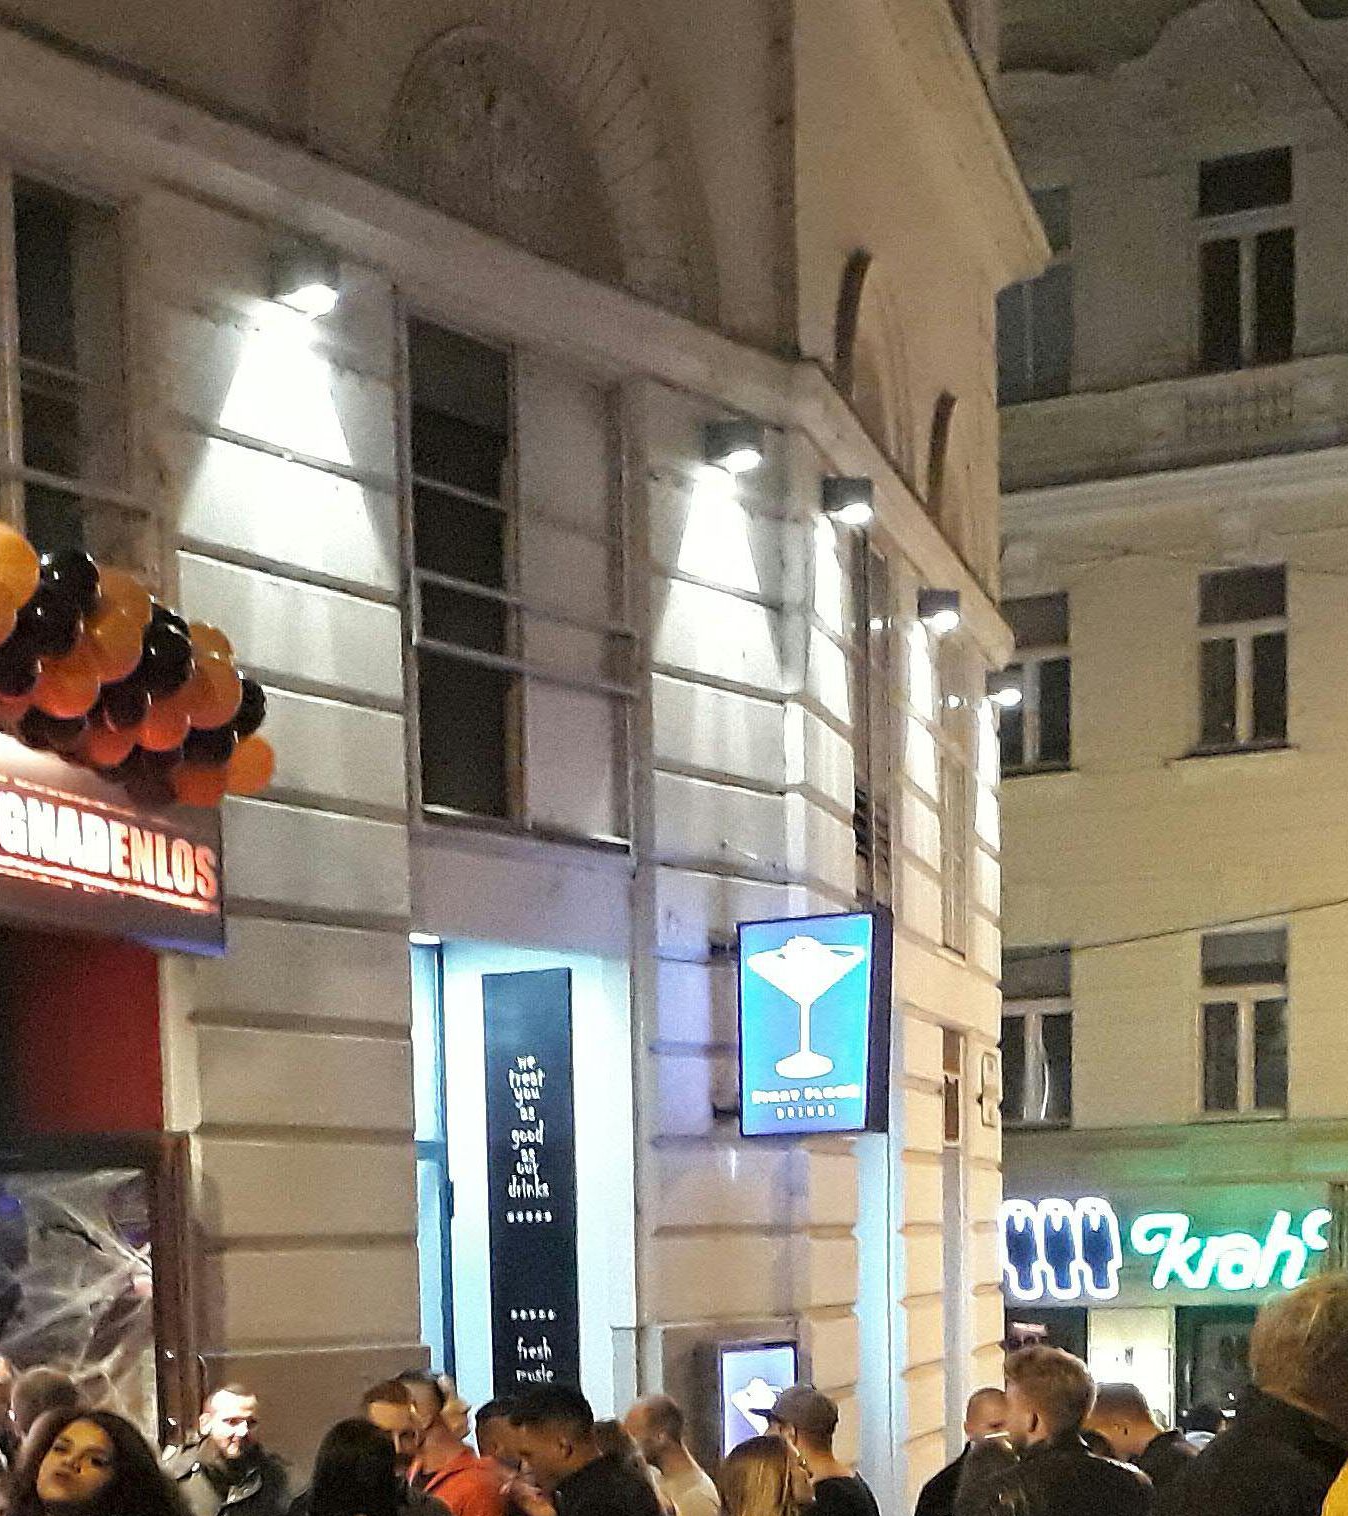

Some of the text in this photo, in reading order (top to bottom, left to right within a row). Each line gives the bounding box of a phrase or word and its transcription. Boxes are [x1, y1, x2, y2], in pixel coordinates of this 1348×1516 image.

[513, 1086, 540, 1108] you
[511, 1119, 545, 1150] good
[507, 1174, 550, 1199] drinks
